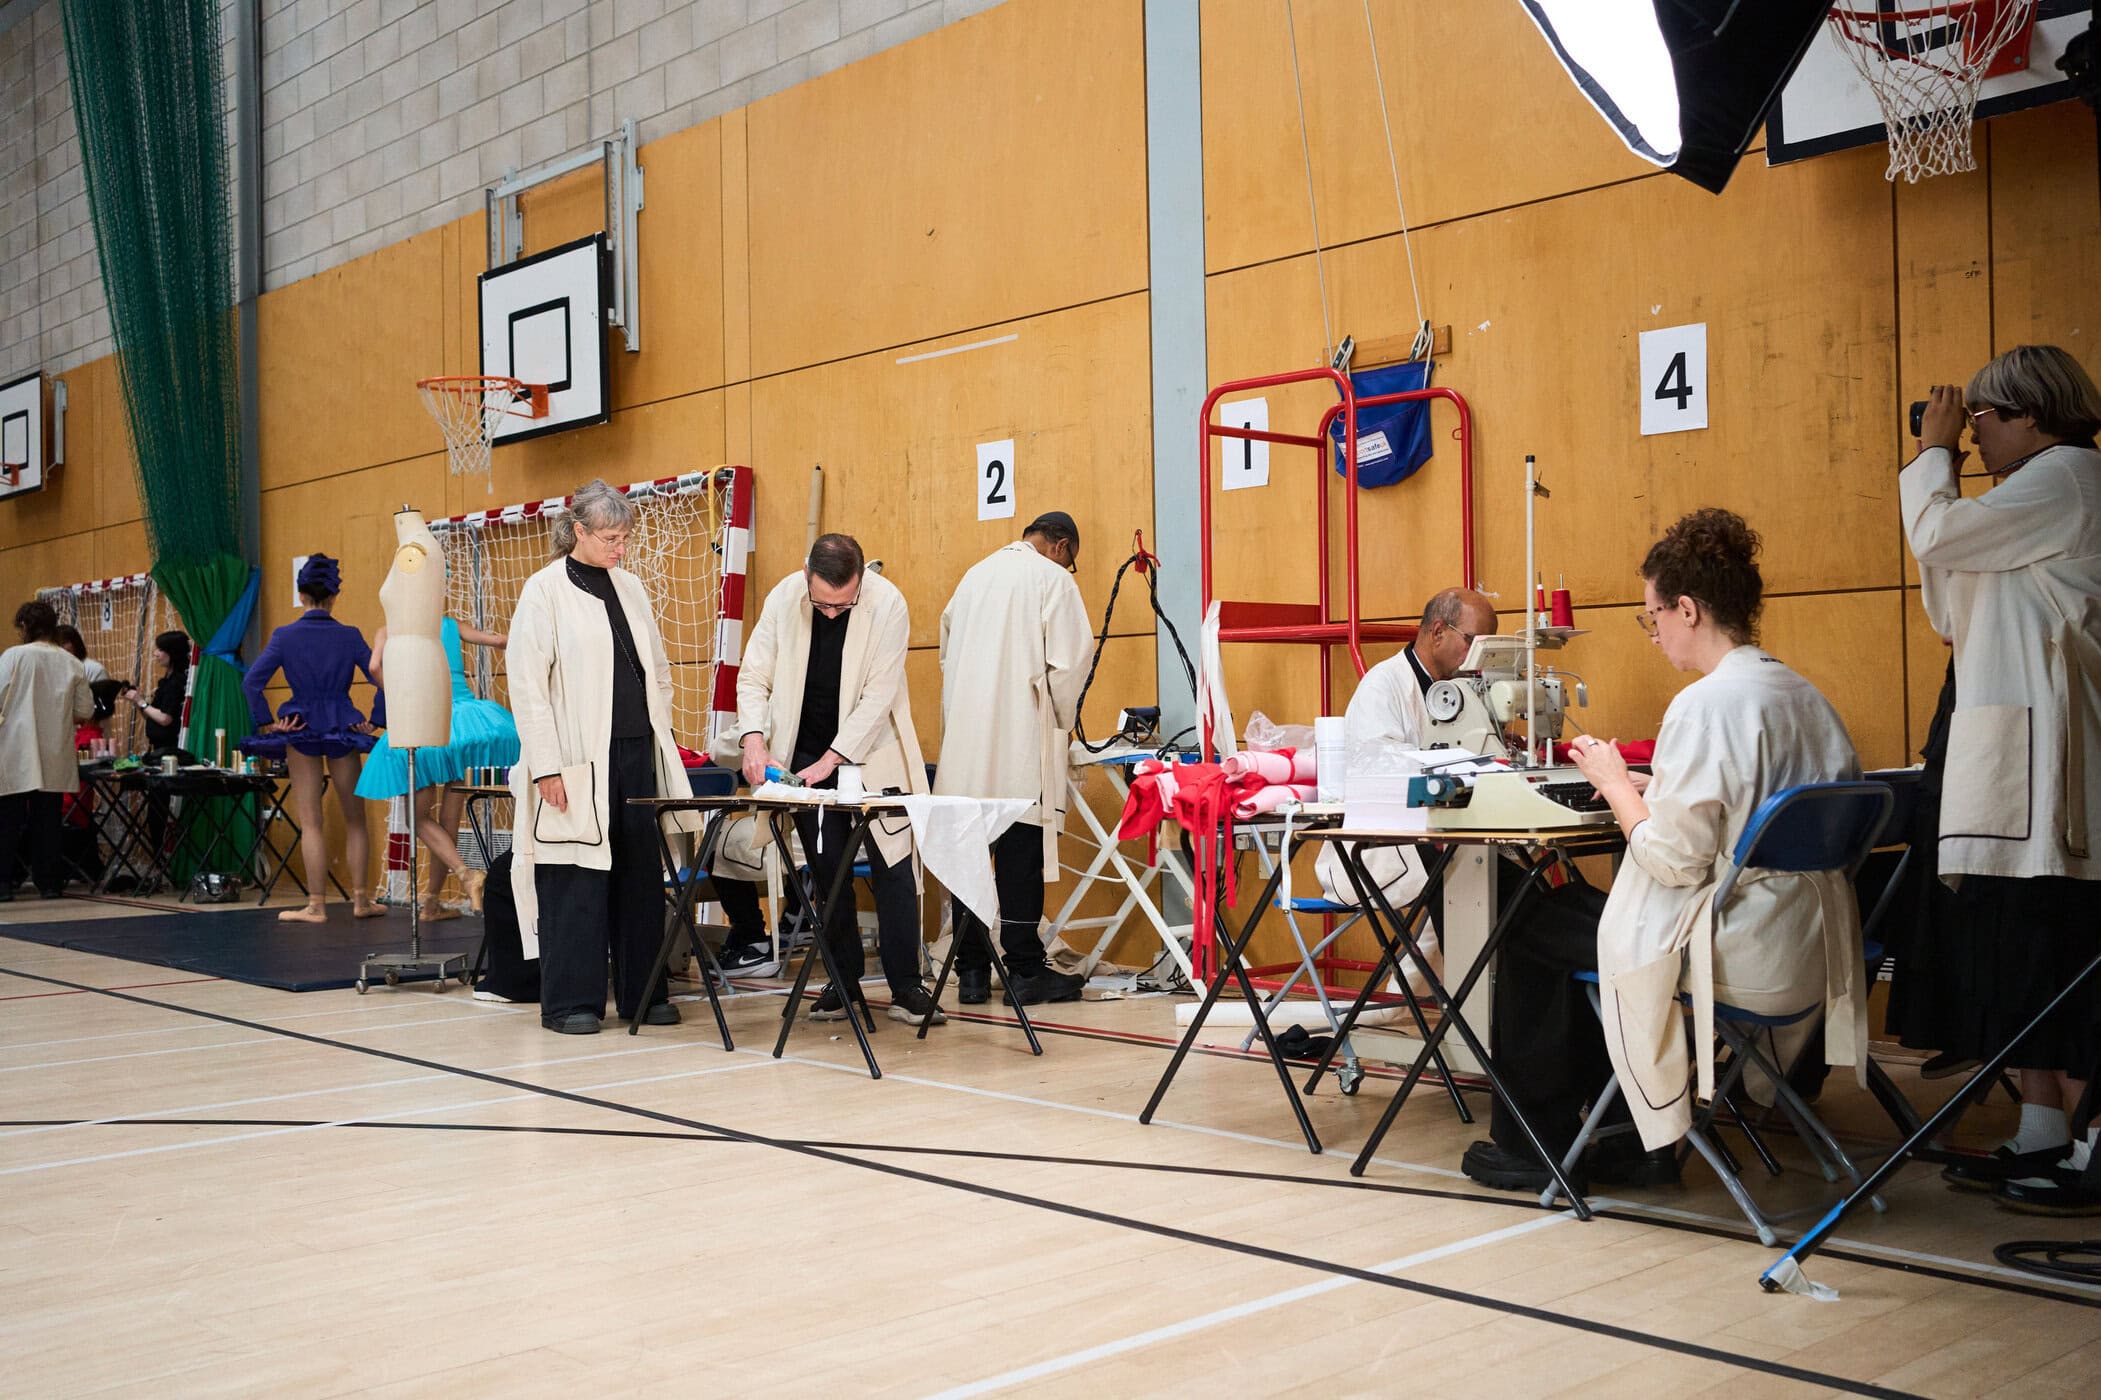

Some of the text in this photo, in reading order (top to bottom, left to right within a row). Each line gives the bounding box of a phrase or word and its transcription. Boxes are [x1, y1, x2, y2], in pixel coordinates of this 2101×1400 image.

[1655, 352, 1693, 410] 4
[1244, 422, 1252, 470] 1
[986, 459, 1007, 505] 2
